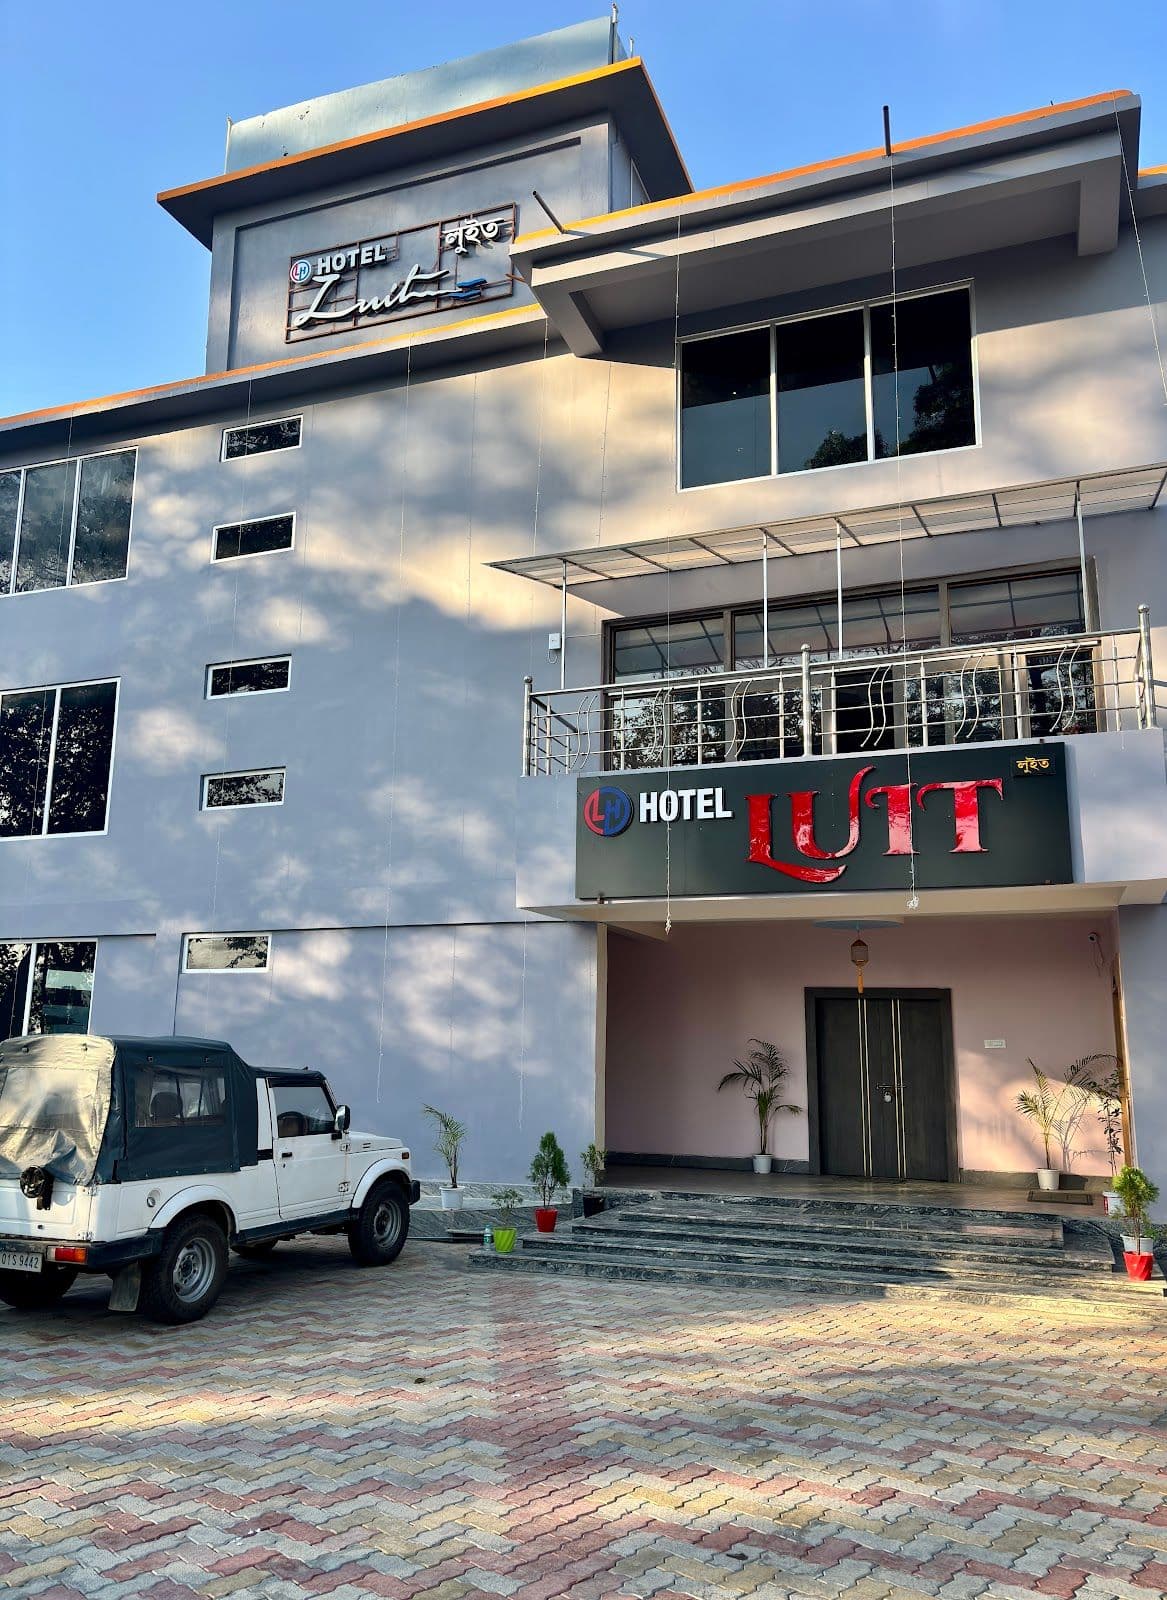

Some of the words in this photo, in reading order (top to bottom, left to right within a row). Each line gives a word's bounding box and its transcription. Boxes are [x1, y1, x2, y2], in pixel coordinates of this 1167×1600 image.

[443, 218, 505, 253] লুইত
[316, 244, 386, 276] HOTEL
[294, 264, 463, 328] Luit
[1016, 756, 1050, 773] লুইত
[639, 787, 733, 823] HOTEL
[744, 765, 1005, 884] LUIT
[20, 1255, 39, 1269] 9442
